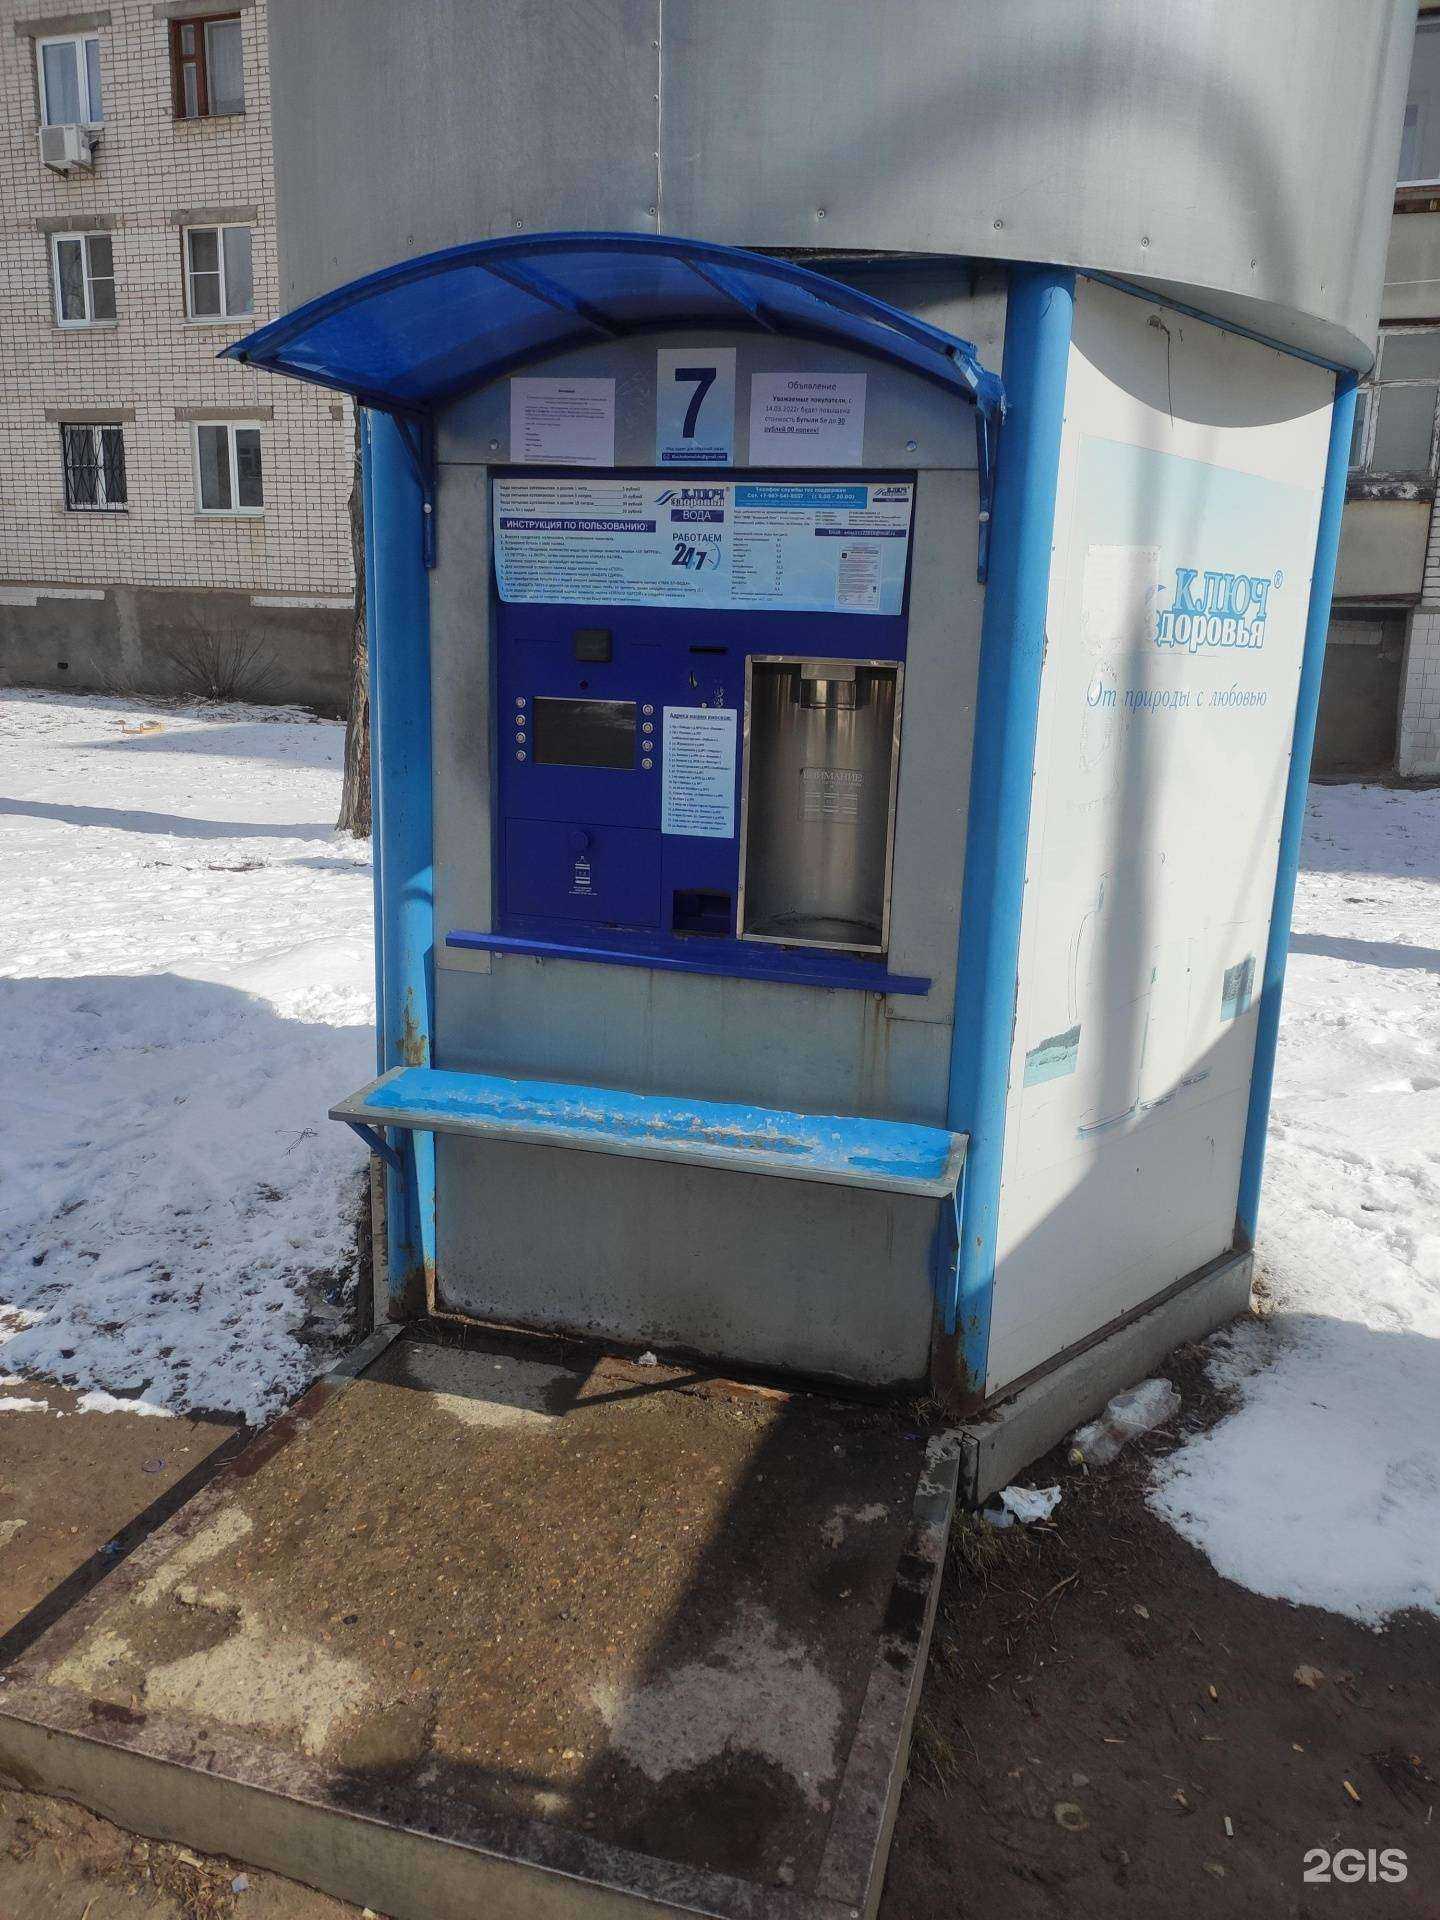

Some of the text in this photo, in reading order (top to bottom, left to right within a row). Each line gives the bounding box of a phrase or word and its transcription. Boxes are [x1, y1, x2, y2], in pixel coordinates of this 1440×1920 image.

[787, 381, 837, 391] Объявление
[674, 367, 717, 438] 7
[681, 488, 724, 500] КЛЮЧ
[683, 510, 712, 521] ВОДА
[506, 520, 649, 532] ИНСТРУКЦИЯ ПО ПОЛЬЗОВАНИЮ:
[672, 533, 722, 543] РАБОТАЕМ
[1172, 567, 1271, 620] КЛЮЧ
[1086, 680, 1268, 714] От природы с любовью
